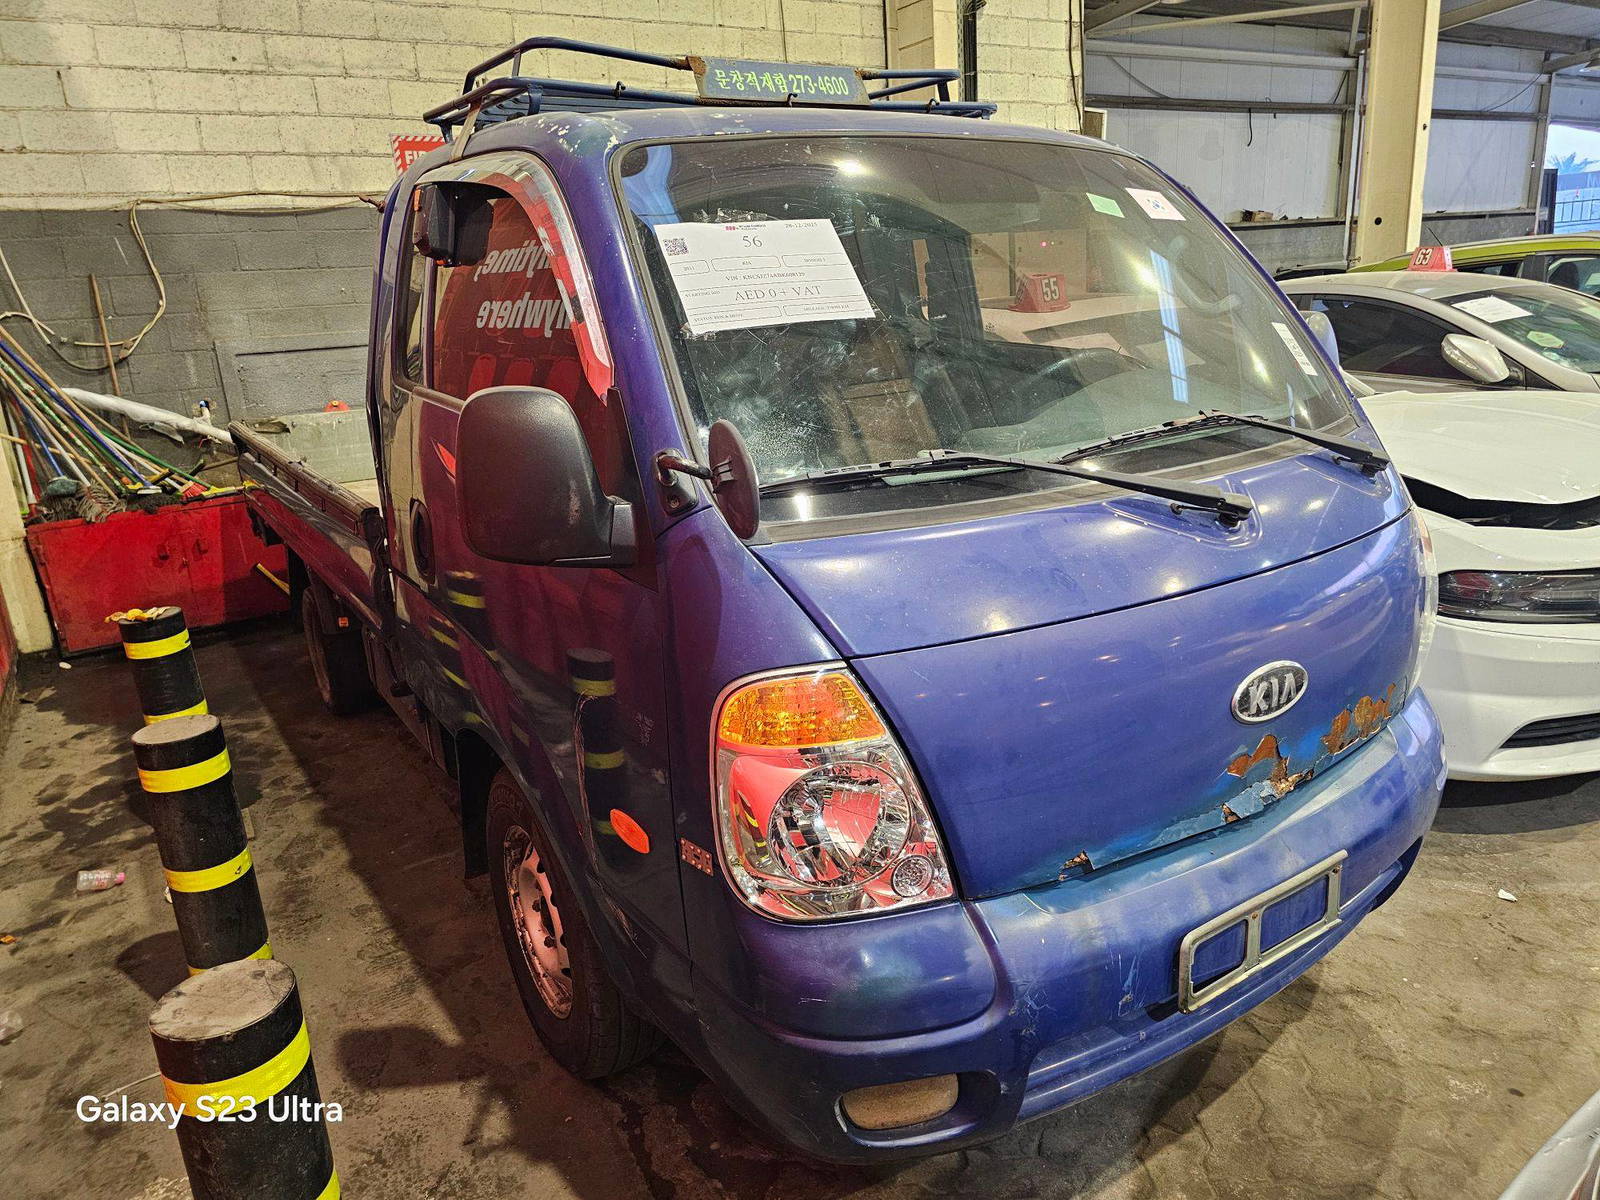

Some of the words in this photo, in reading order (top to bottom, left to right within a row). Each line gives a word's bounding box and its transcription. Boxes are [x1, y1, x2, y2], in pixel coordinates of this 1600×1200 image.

[742, 235, 763, 248] 56
[1414, 248, 1433, 265] 63
[735, 289, 765, 301] AED
[768, 288, 777, 298] 0
[792, 285, 822, 296] VAT
[1041, 277, 1060, 302] 55
[1247, 673, 1298, 715] KIA
